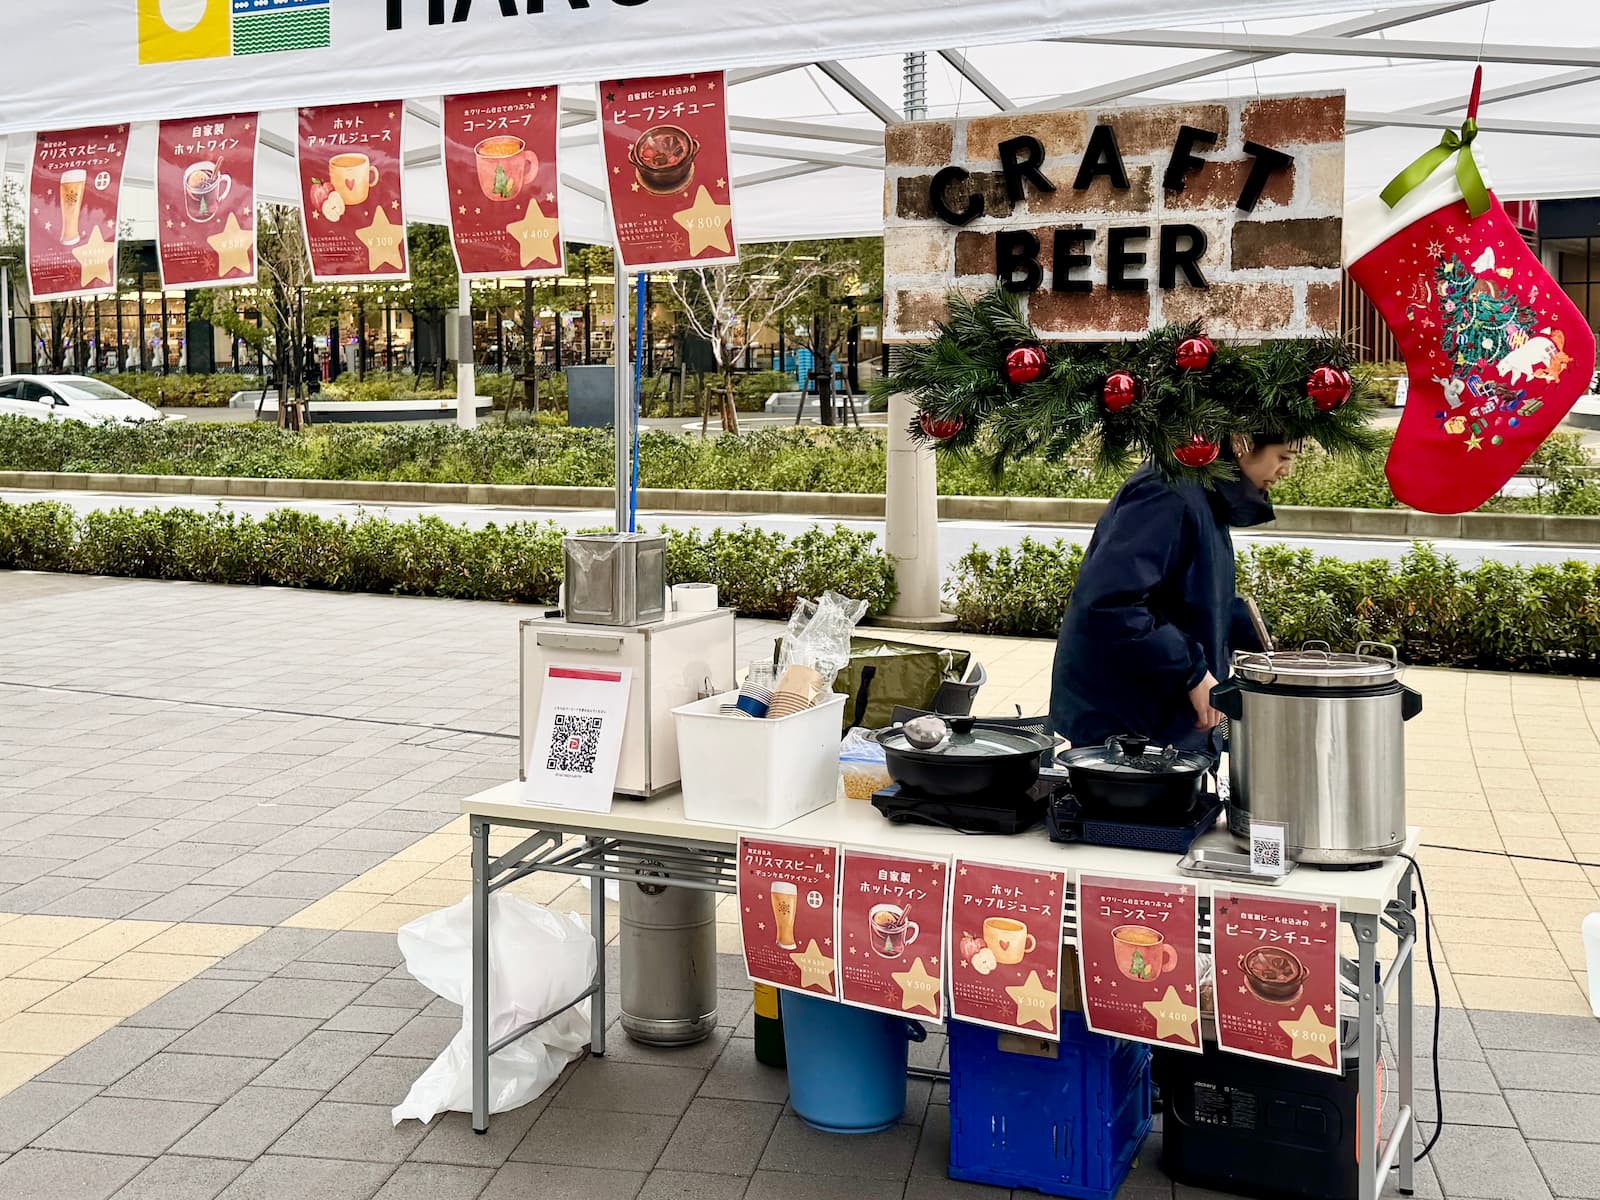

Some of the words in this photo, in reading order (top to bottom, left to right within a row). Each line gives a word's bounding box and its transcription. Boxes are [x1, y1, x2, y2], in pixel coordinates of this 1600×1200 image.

[628, 85, 697, 101] 自家製ビール仕込みの
[464, 103, 535, 116] 生クリーム仕立てのつぶつぶ
[613, 102, 716, 124] ビーフシチュー
[192, 123, 224, 137] 自家製
[333, 116, 364, 129] ホット
[463, 114, 532, 132] コーンスープ
[174, 139, 239, 155] ホットワイン
[307, 130, 392, 147] アップルジュース
[40, 143, 117, 161] クリスマスビール
[928, 125, 1294, 227] CRAFT
[996, 224, 1210, 293] BEER
[745, 855, 824, 873] クリスマスビール
[878, 869, 911, 884] 自家製
[859, 881, 927, 900] ホットワイン
[991, 884, 1024, 897] ホット
[962, 894, 1052, 916] アップルジュース
[1100, 895, 1173, 909] 生クリーム仕立てのつぶつぶ
[1100, 905, 1170, 922] コーンスープ
[1240, 912, 1310, 927] 自家製ビール仕込みの
[1225, 923, 1328, 946] ビーフシチュー
